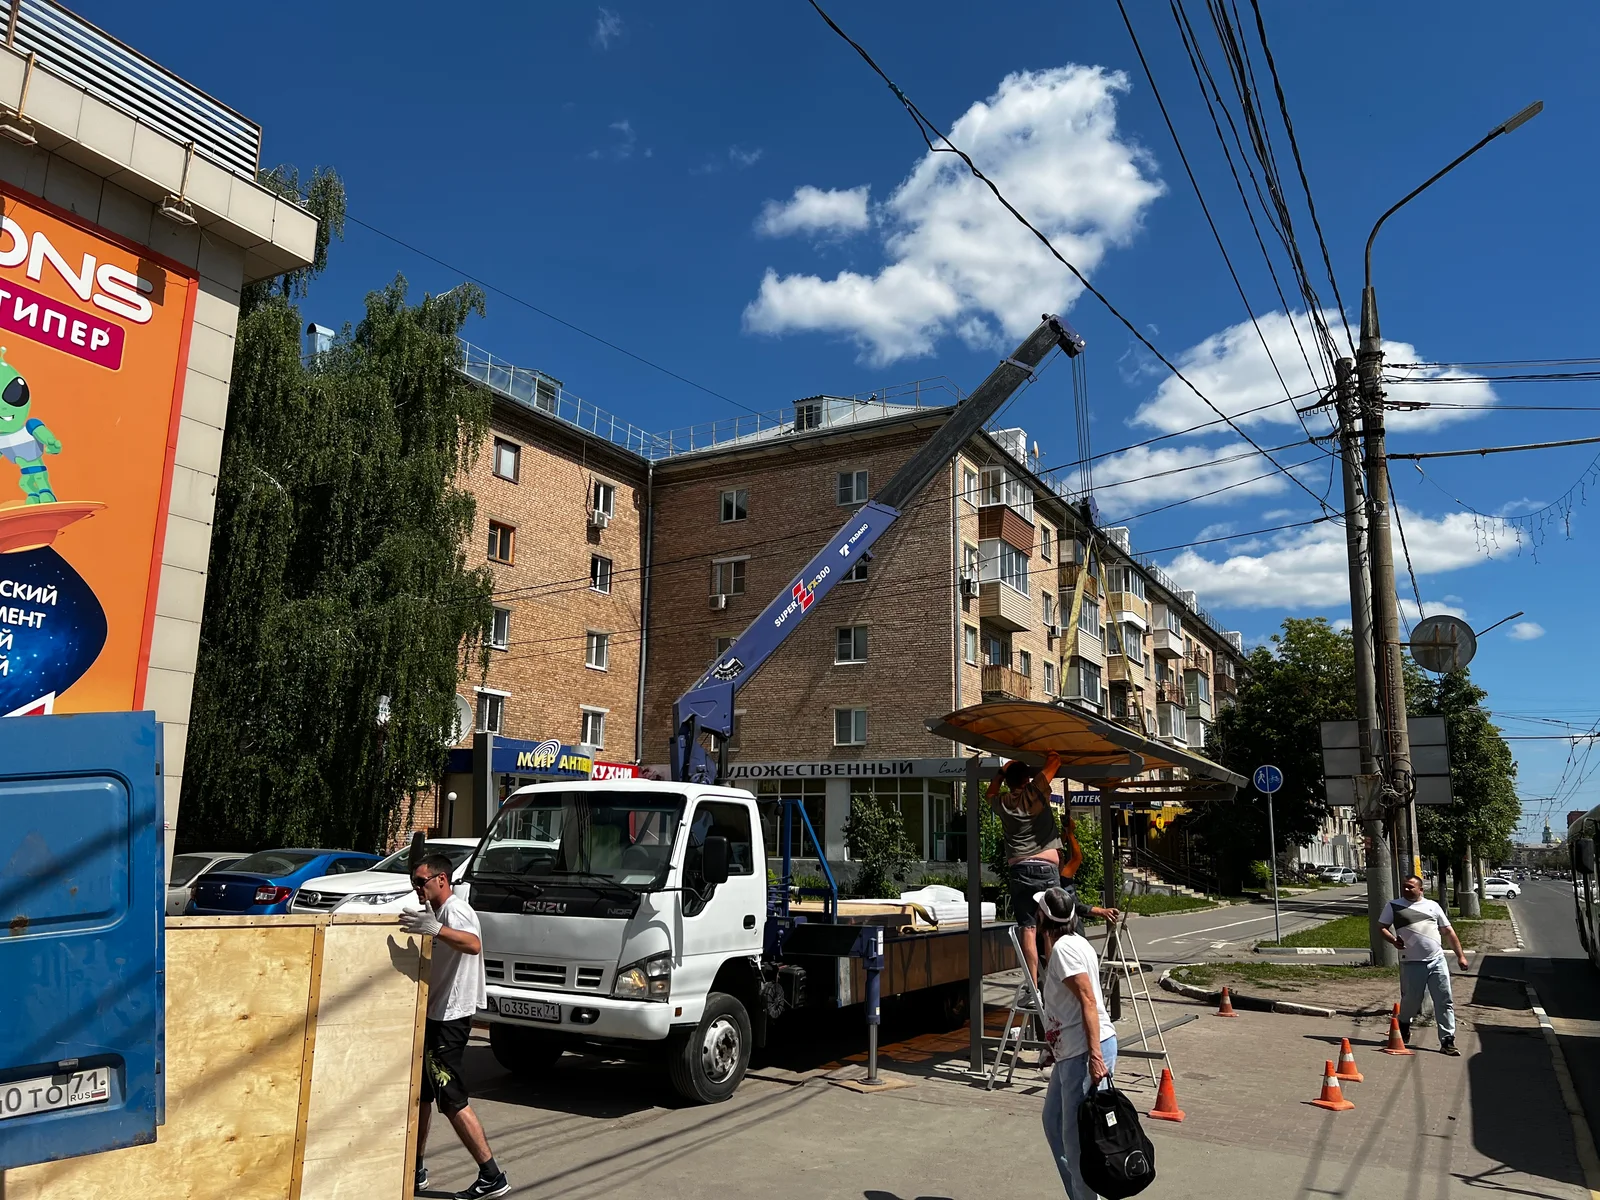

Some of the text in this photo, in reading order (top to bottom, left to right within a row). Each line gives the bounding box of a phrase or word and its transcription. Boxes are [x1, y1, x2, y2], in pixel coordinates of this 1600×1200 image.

[849, 523, 869, 544] TADANO
[0, 580, 58, 606] СКИЙ
[774, 600, 798, 627] SUPER
[807, 565, 831, 593] FX300
[516, 752, 556, 768] МИР
[592, 764, 633, 780] КУХНИ
[522, 900, 567, 914] ISUZU
[545, 1005, 556, 1015] 71
[71, 1071, 98, 1093] 71
[70, 1092, 91, 1102] RUS
